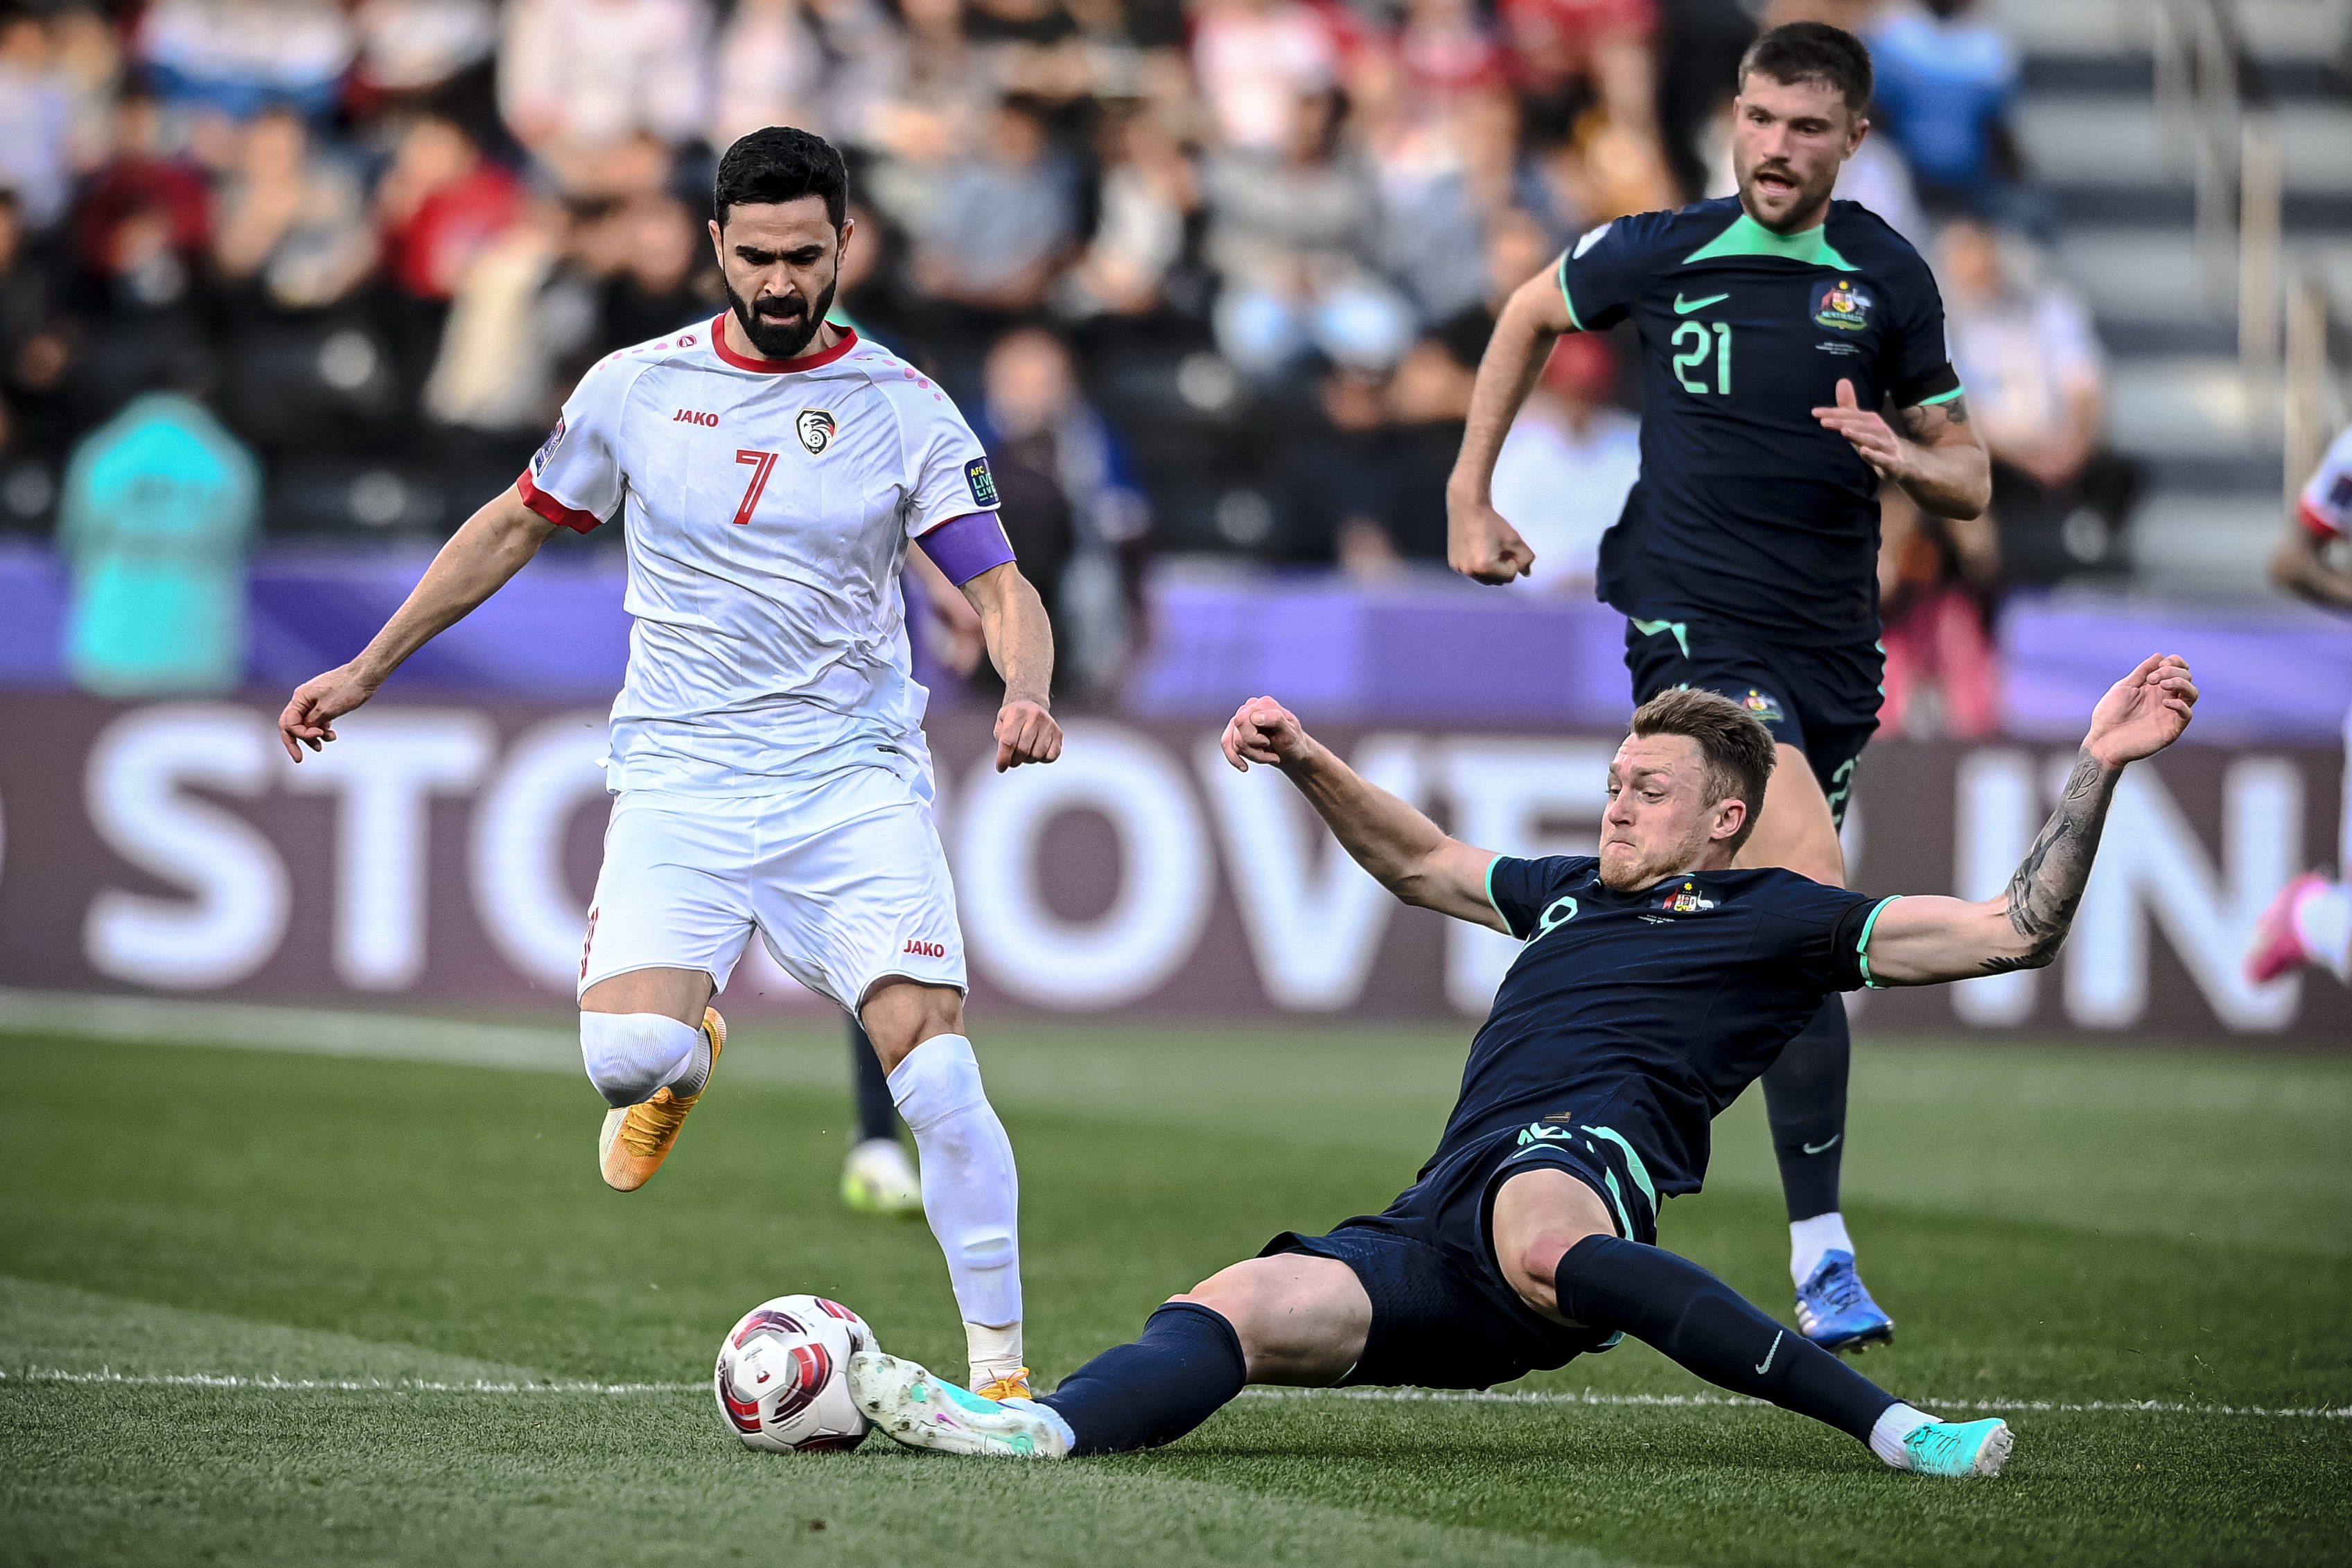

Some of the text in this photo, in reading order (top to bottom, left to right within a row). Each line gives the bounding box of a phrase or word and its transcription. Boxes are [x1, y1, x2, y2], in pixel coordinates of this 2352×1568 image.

[1671, 321, 1731, 395] 21
[673, 409, 719, 428] JAKO
[732, 449, 780, 525] 7
[971, 466, 985, 477] AFC
[1951, 750, 2304, 1030] IN
[904, 940, 945, 958] JAKO
